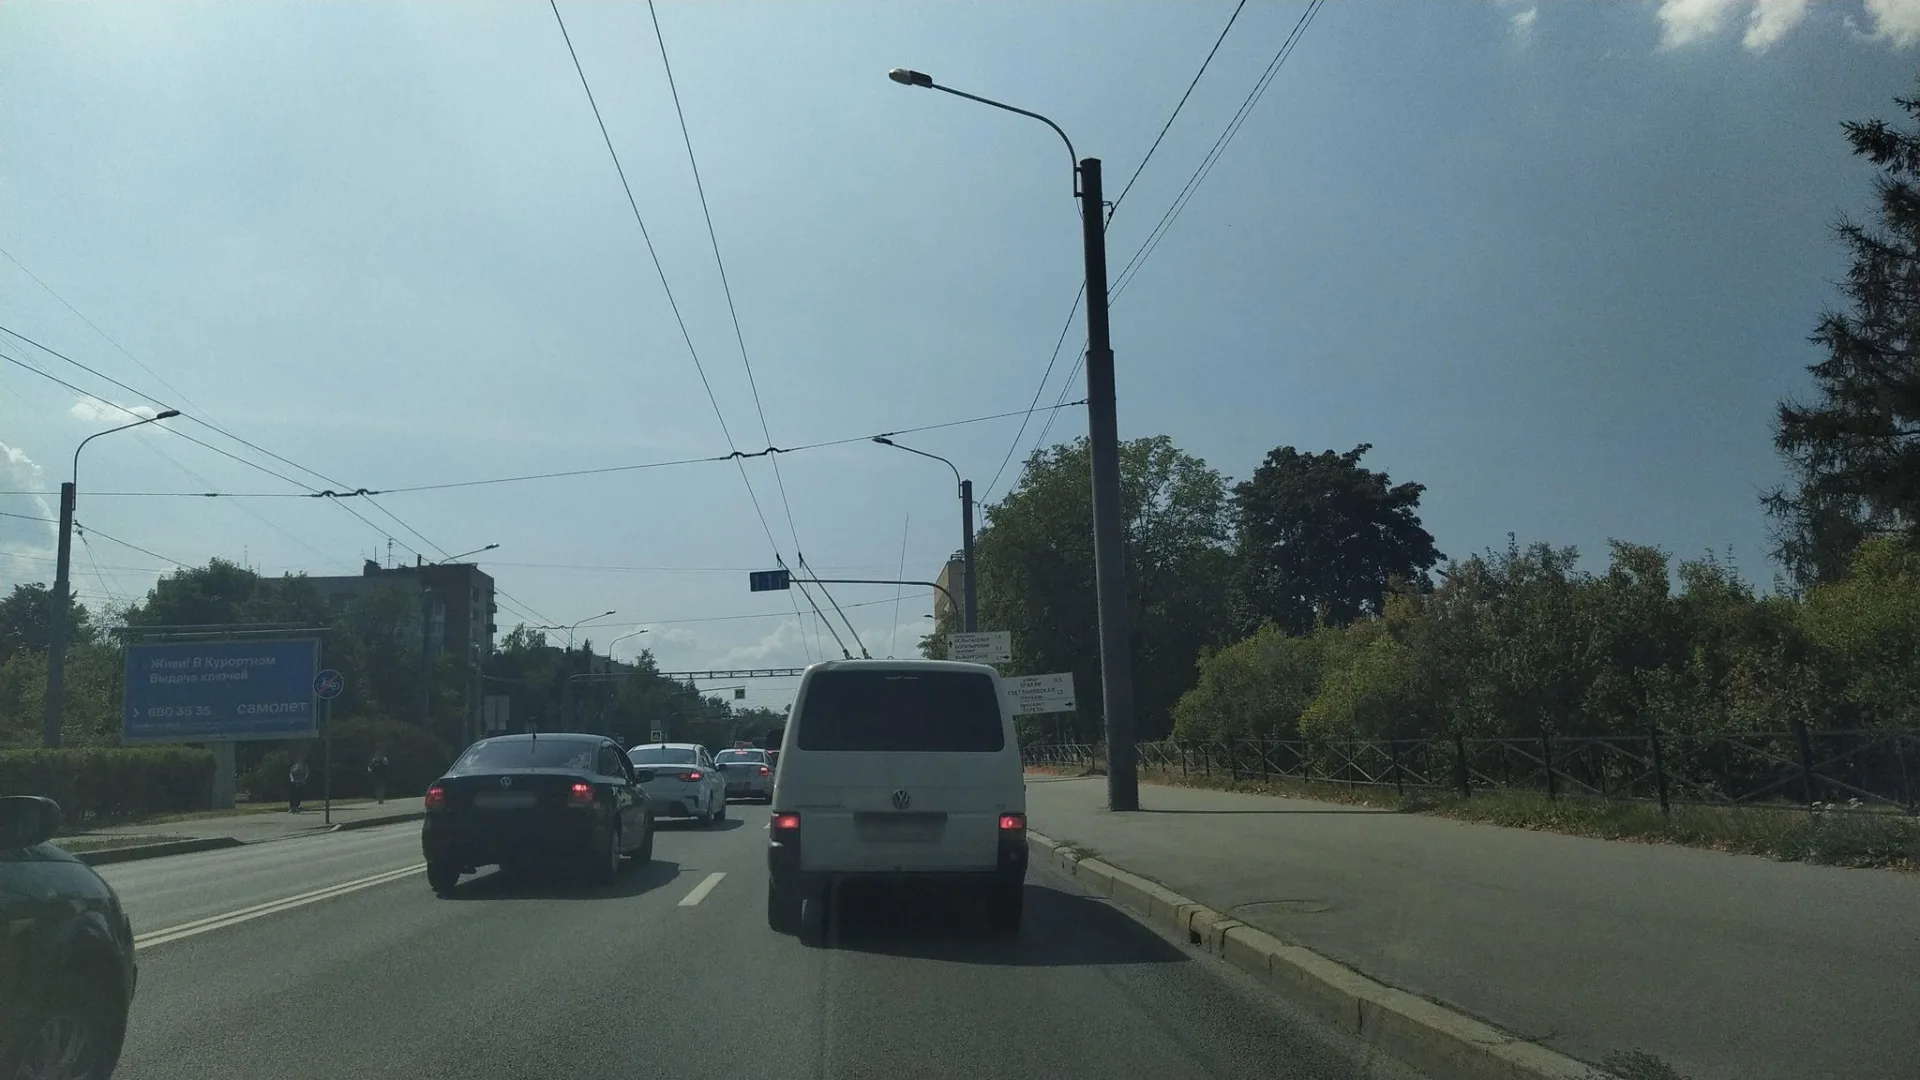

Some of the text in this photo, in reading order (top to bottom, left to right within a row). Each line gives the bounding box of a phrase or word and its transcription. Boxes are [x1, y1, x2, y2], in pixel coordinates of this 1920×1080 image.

[150, 656, 276, 670] Живи! В Курортном
[149, 669, 248, 685] Выдача ключей
[237, 702, 308, 716] самолет
